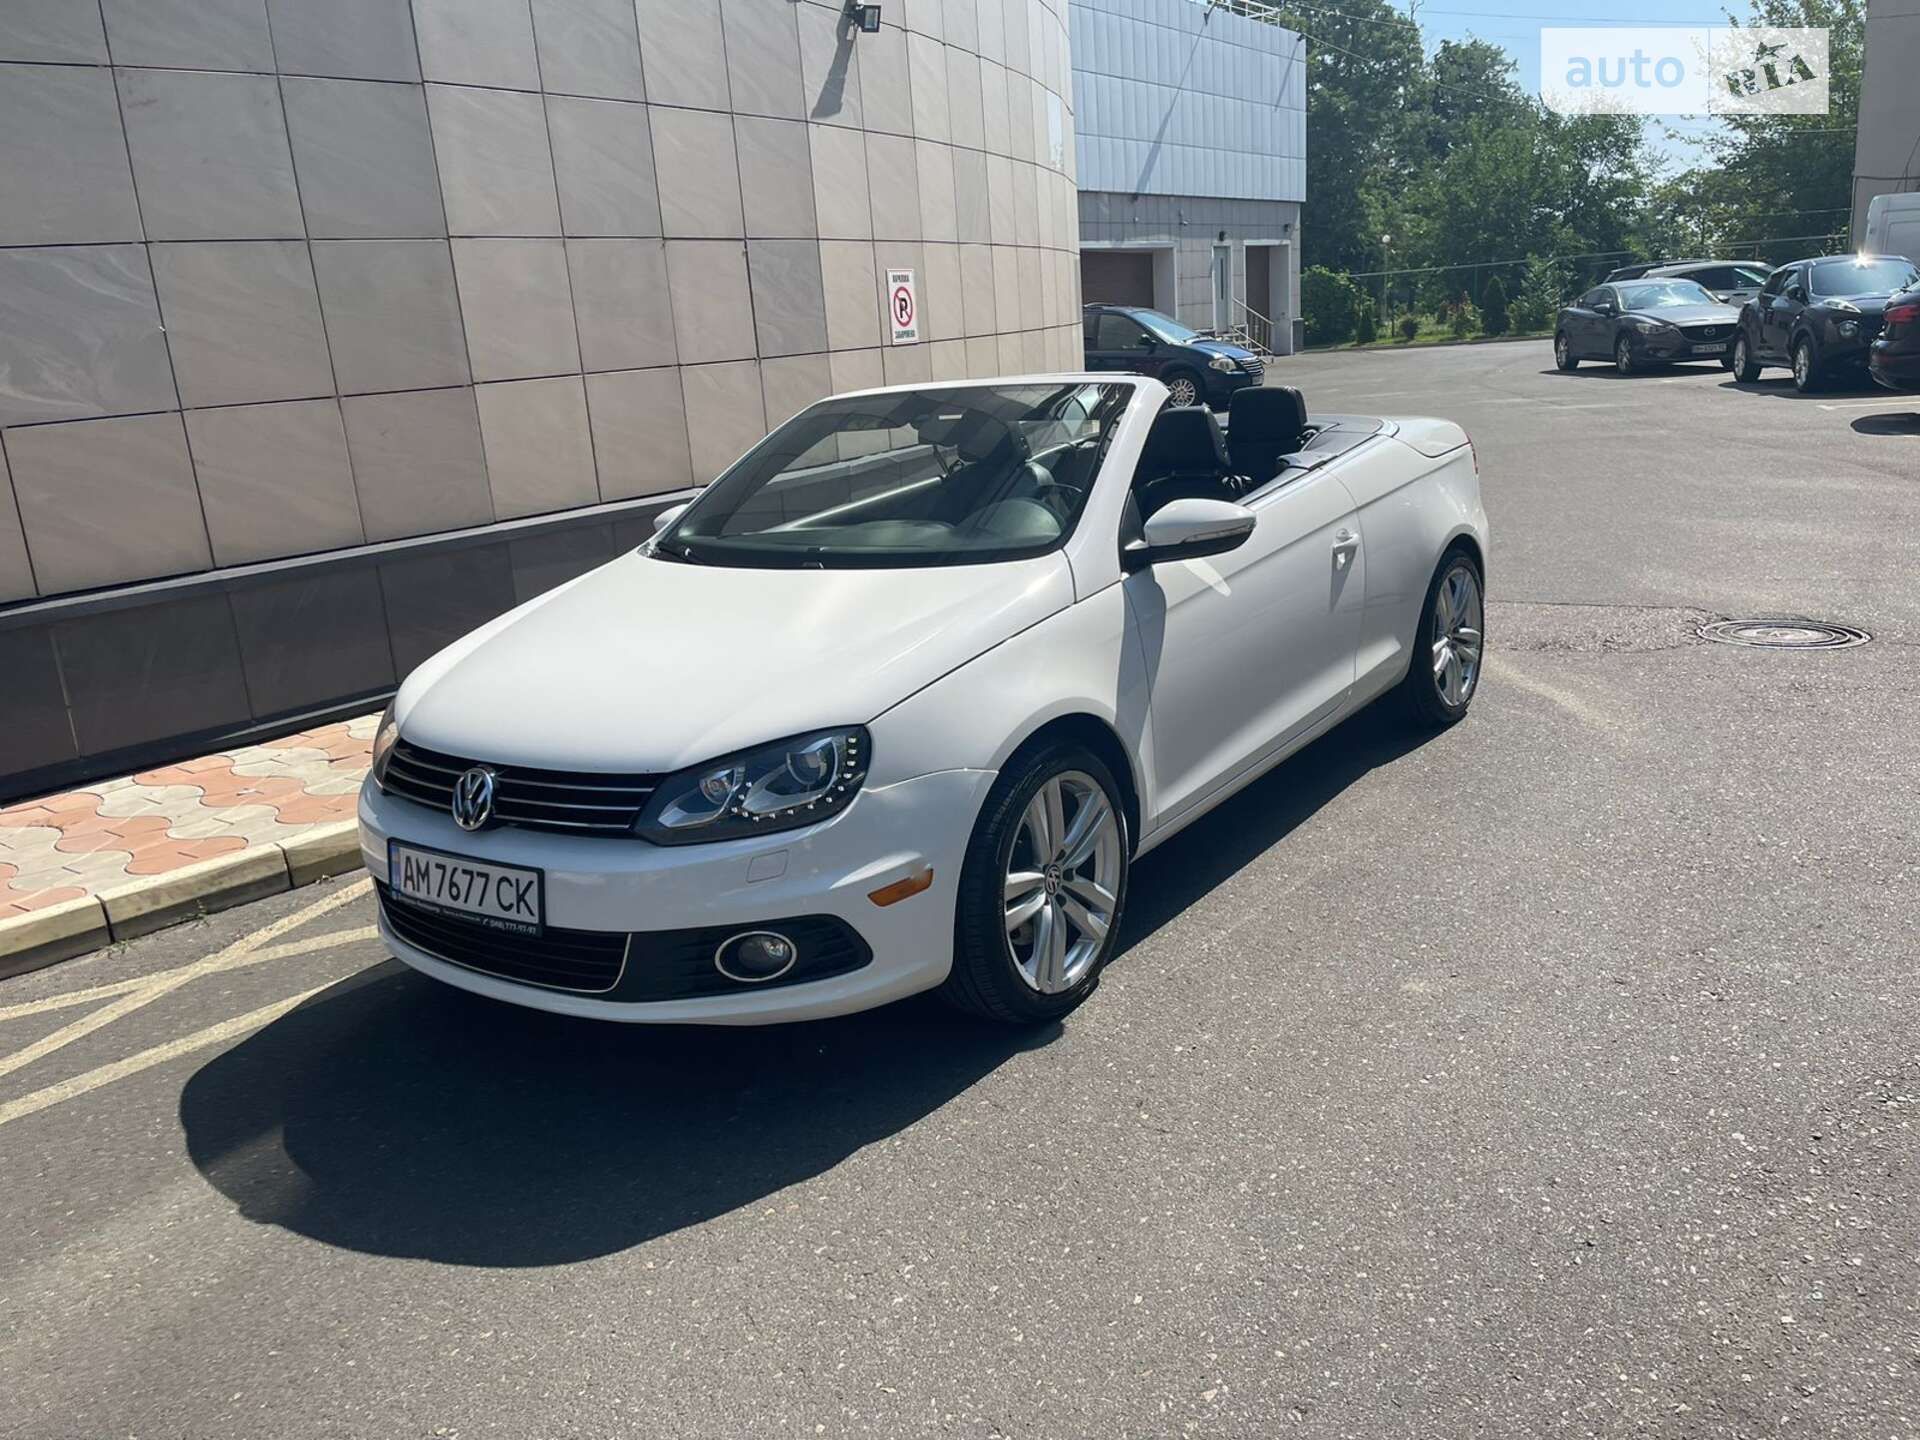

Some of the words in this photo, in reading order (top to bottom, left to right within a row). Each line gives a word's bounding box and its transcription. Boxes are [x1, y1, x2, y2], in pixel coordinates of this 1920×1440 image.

[403, 855, 430, 895] AM
[435, 863, 490, 907] 7677
[496, 876, 536, 917] CK
